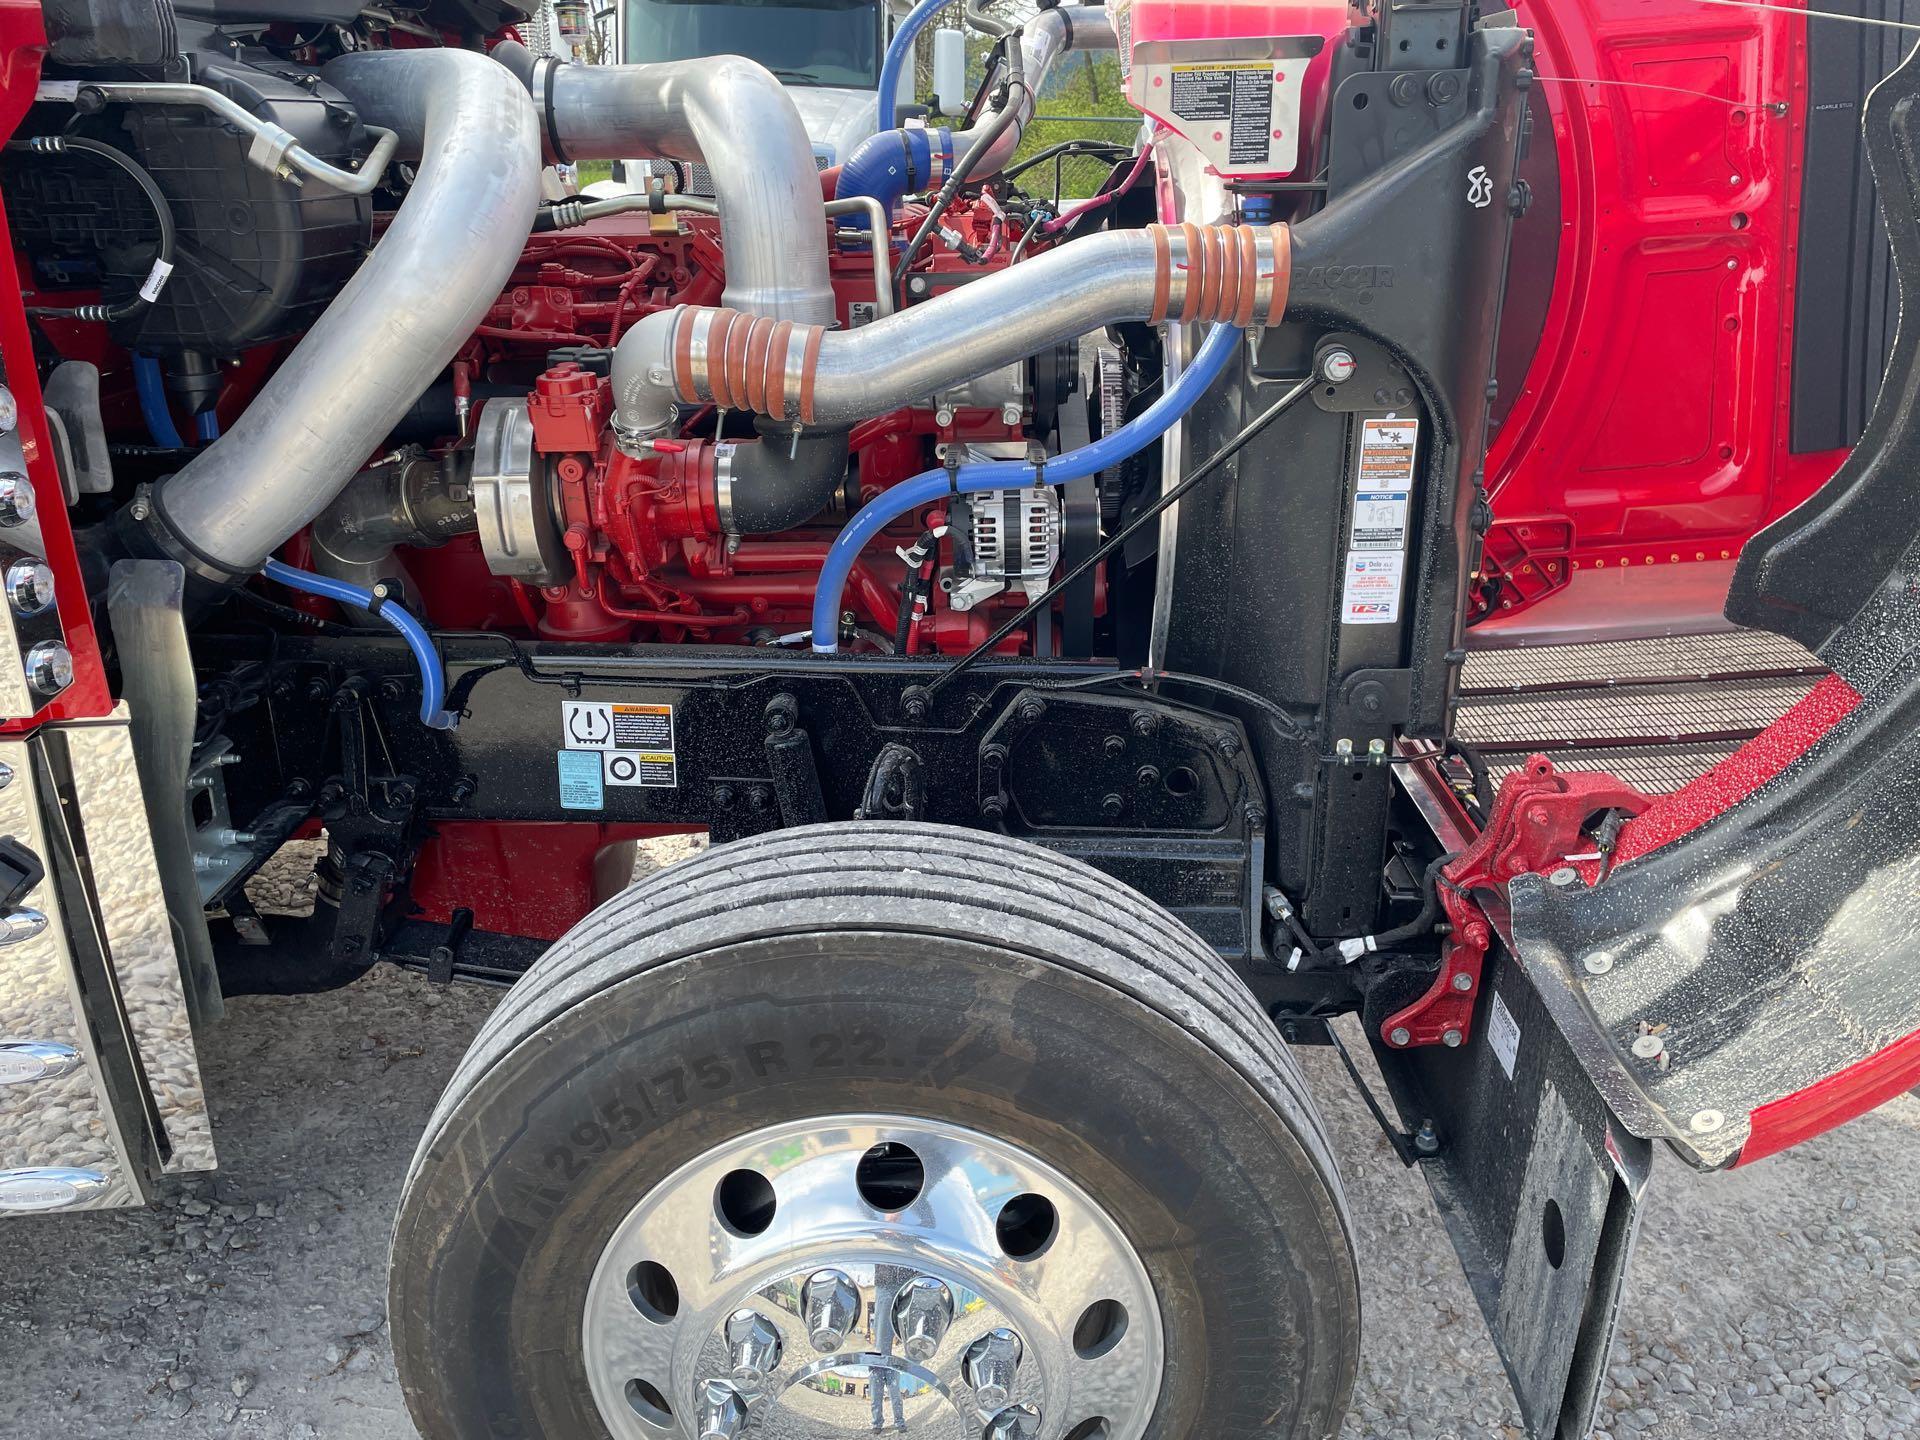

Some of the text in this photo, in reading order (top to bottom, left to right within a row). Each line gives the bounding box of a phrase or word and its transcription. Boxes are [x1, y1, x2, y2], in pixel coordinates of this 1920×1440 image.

[1467, 165, 1493, 208] 83
[1294, 265, 1394, 289] PACCAR
[542, 1054, 733, 1181] 295/75
[745, 1039, 791, 1077] R
